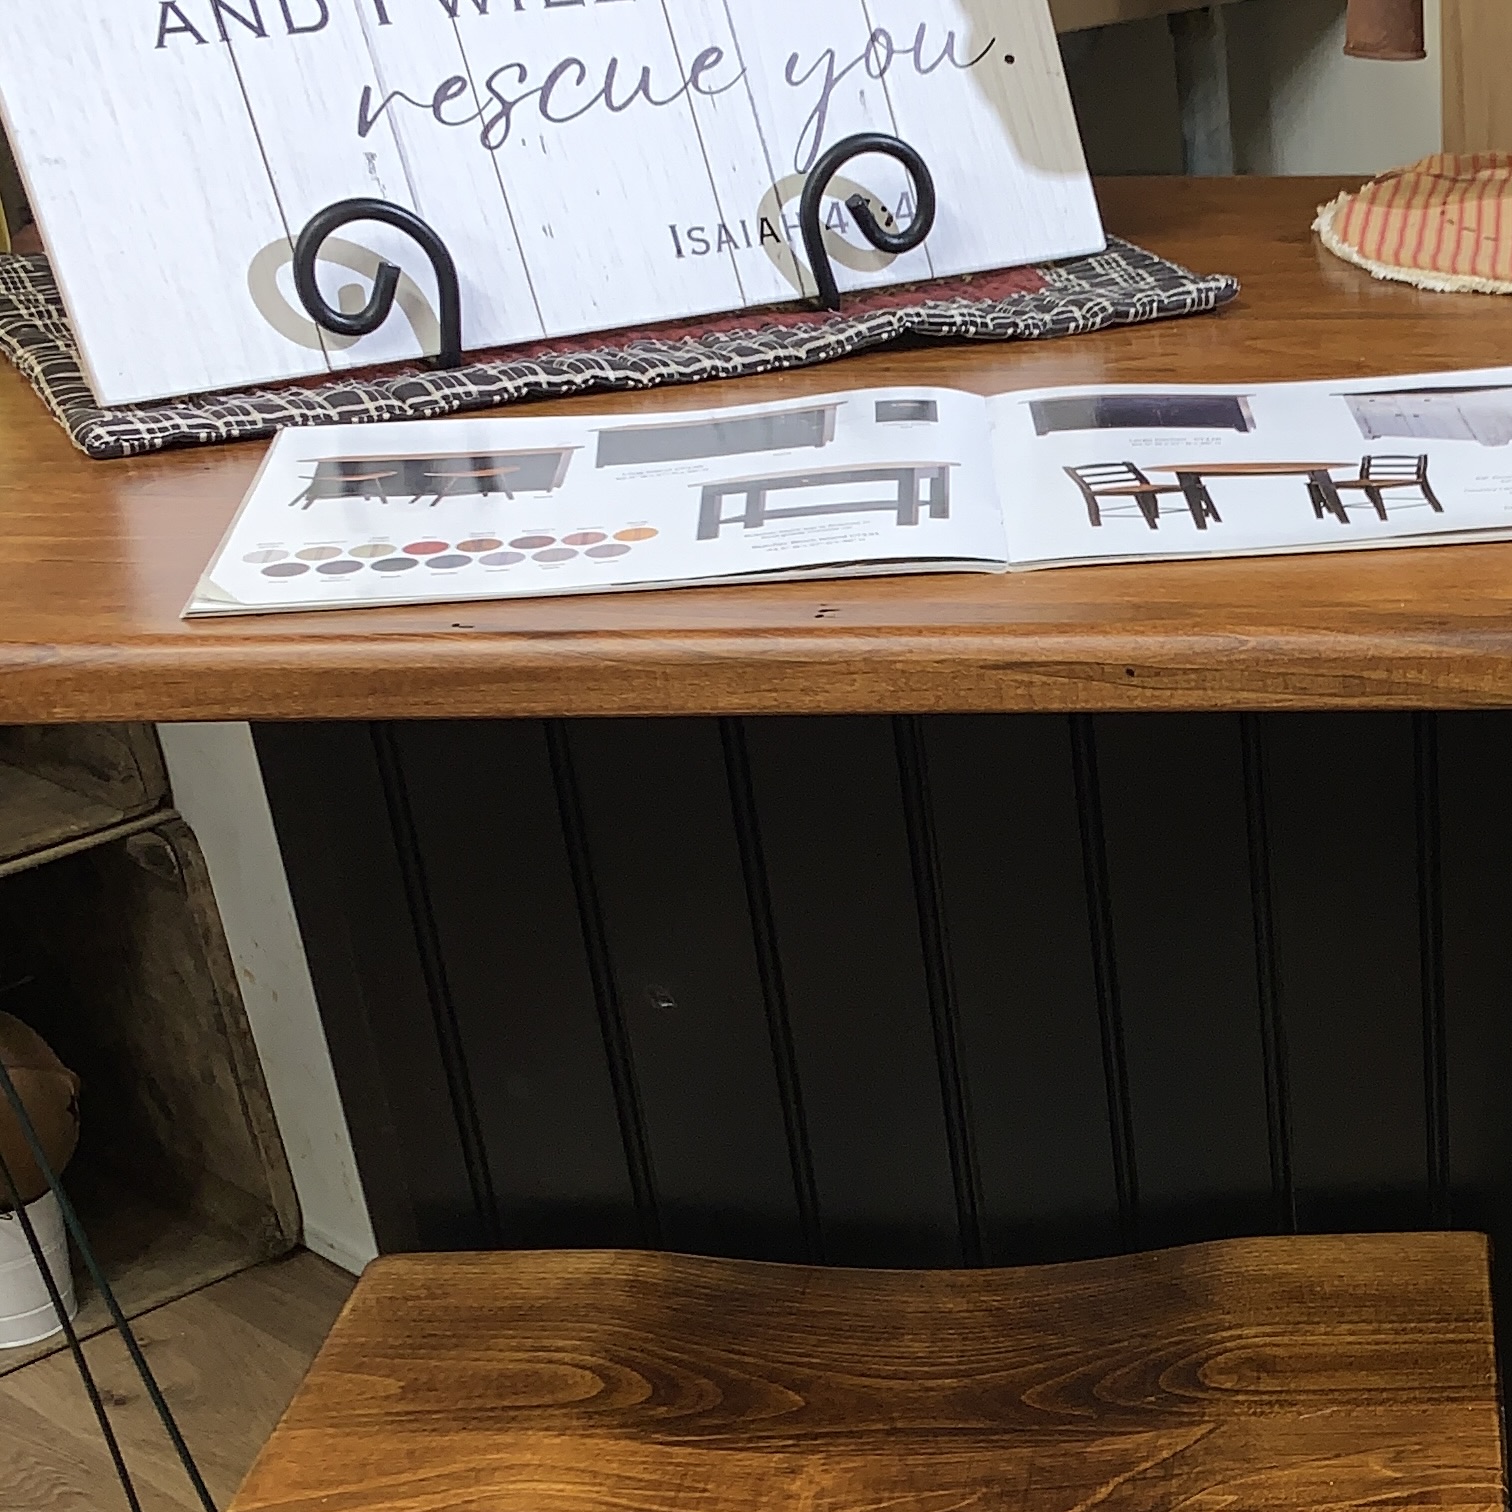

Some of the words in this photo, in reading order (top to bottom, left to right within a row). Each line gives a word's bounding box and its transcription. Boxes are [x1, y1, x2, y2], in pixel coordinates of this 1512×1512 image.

[154, 0, 330, 49] AND
[356, 46, 746, 150] rescue
[784, 22, 1014, 174] you.
